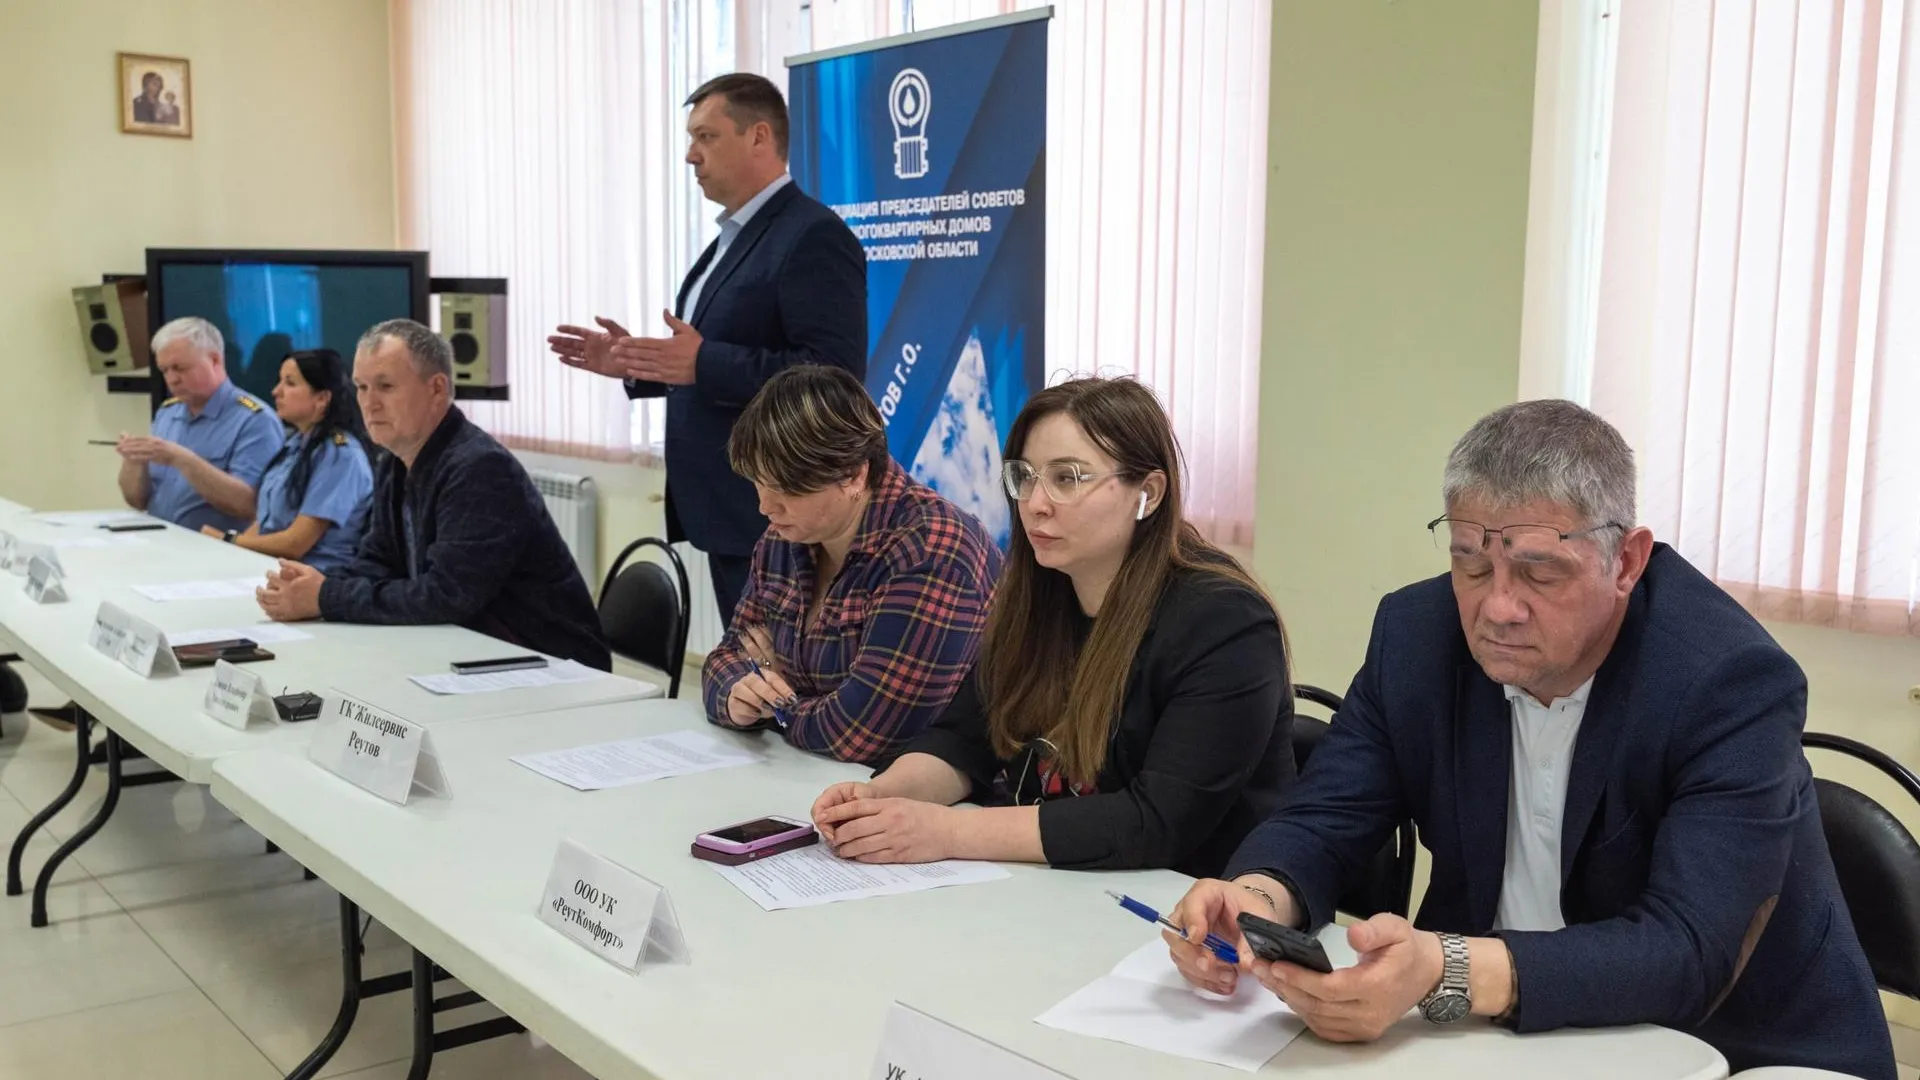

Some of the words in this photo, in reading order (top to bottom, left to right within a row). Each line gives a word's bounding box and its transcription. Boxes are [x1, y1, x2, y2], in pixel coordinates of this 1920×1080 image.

[880, 190, 970, 217] ПРЕДСЕДАТЕЛЕЙ
[971, 189, 1025, 209] СОВЕТОВ
[848, 219, 947, 240] НОГОКВАРТИРНЫХ
[948, 216, 992, 237] ДОМОВ
[864, 240, 925, 261] ОСКОВСКОЙ
[927, 240, 979, 259] ОБЛАСТИ
[339, 699, 356, 718] ГК
[354, 704, 408, 739] Жилсервис
[348, 730, 380, 757] Реутов
[574, 879, 599, 904] ООО
[599, 893, 617, 915] УК
[552, 896, 624, 949] «РеутКомфорт»
